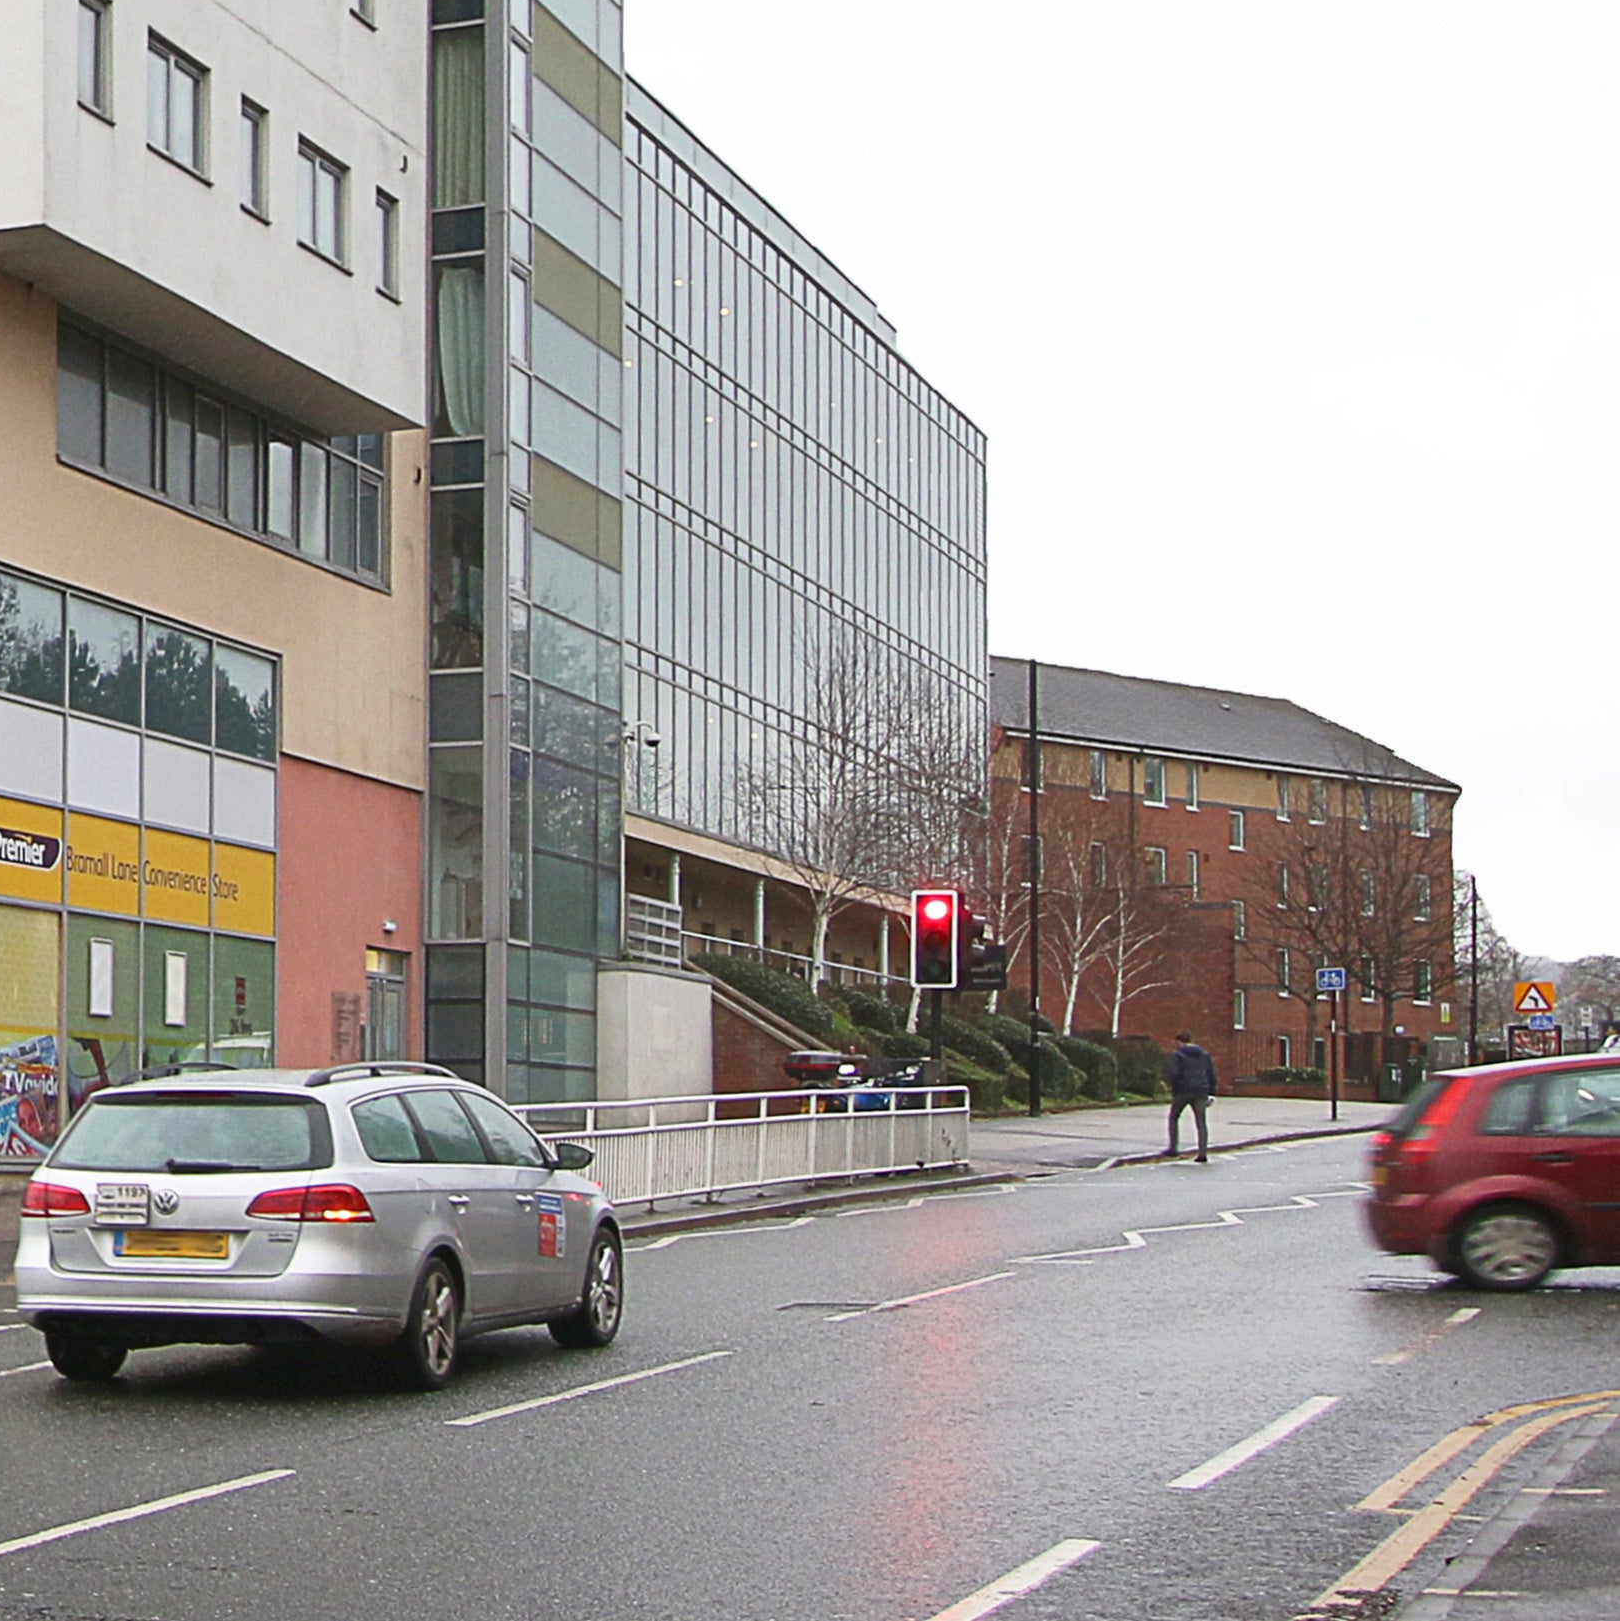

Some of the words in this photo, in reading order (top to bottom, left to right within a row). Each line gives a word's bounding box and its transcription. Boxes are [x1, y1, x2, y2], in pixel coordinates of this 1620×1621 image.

[66, 845, 109, 877] Bramall
[111, 854, 138, 883] Lane
[142, 859, 207, 895] Convenience
[213, 873, 239, 901] Store
